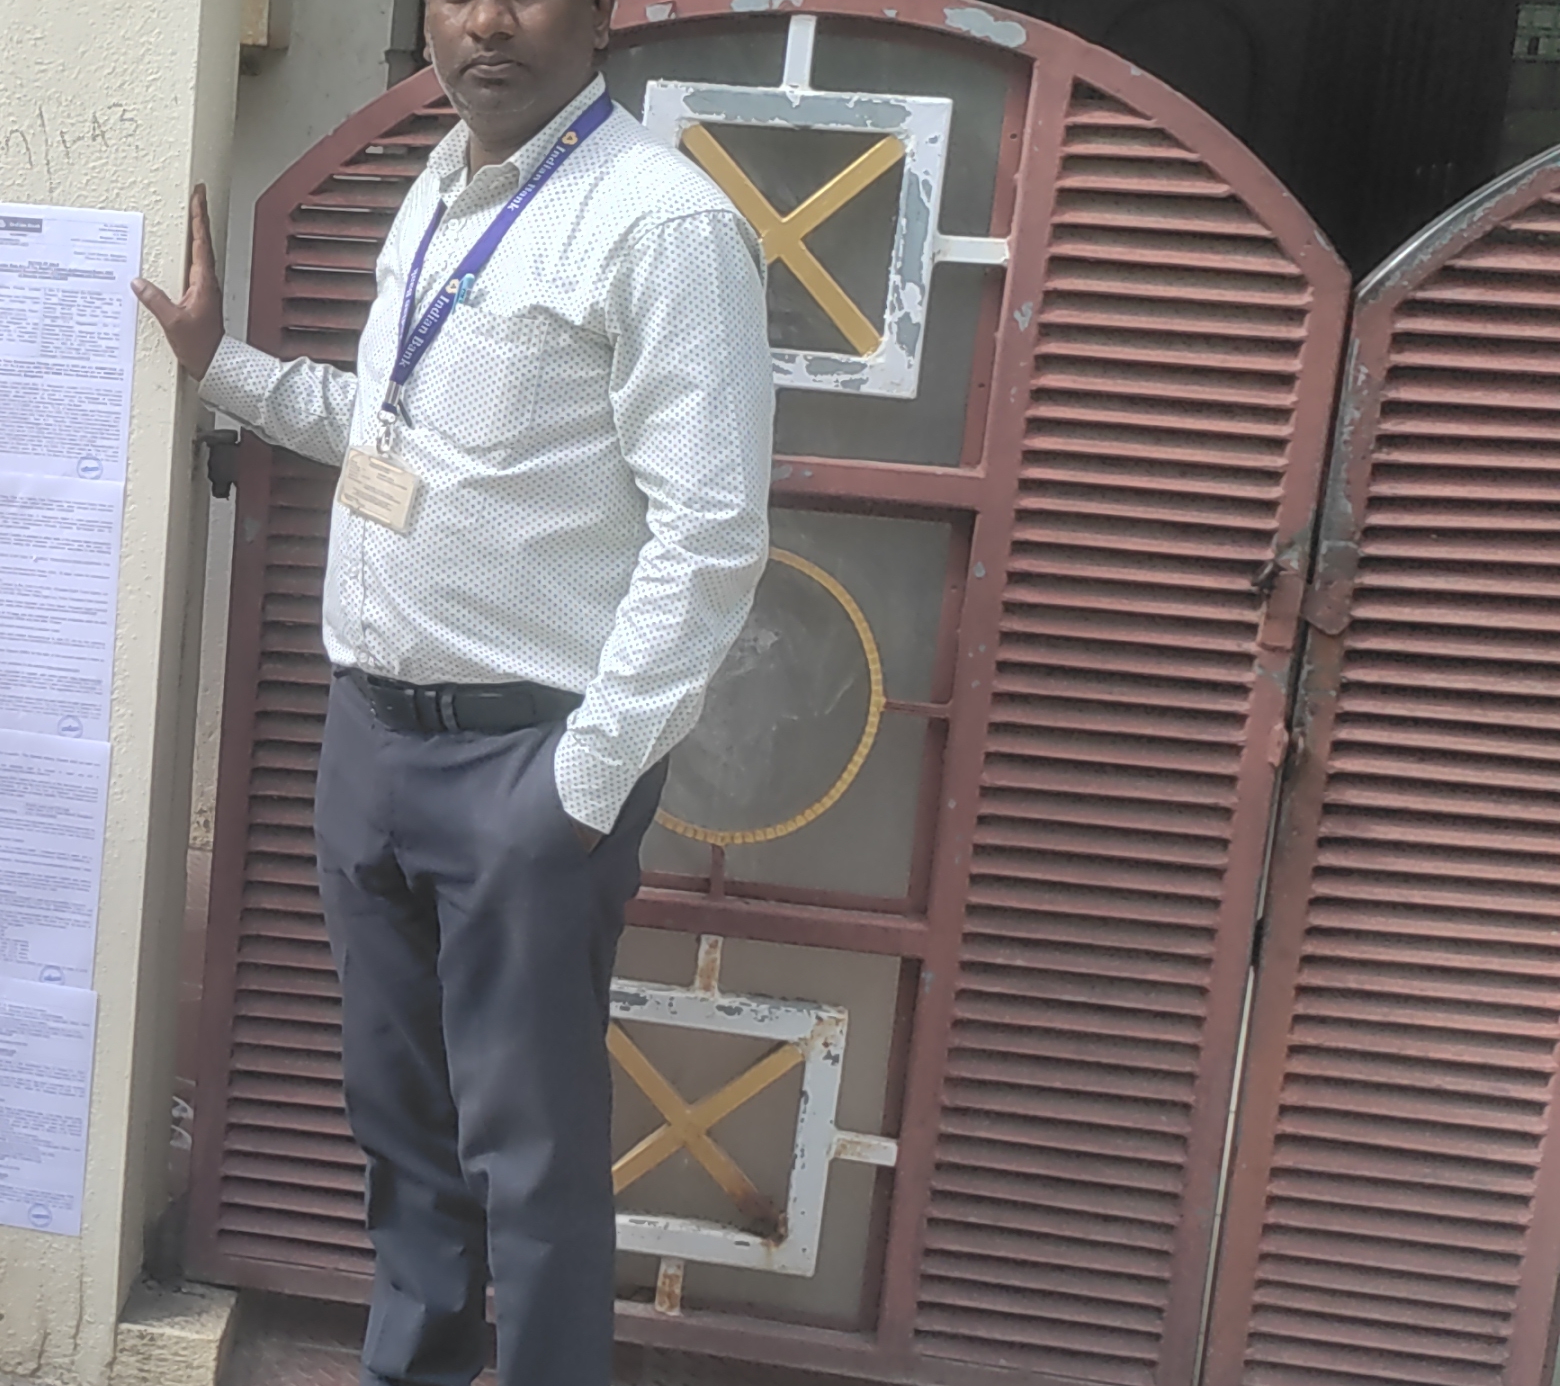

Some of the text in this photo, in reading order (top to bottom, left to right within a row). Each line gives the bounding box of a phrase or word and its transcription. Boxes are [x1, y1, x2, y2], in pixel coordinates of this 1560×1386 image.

[507, 145, 567, 212] Indian Bank
[399, 295, 451, 368] Indian Bank
